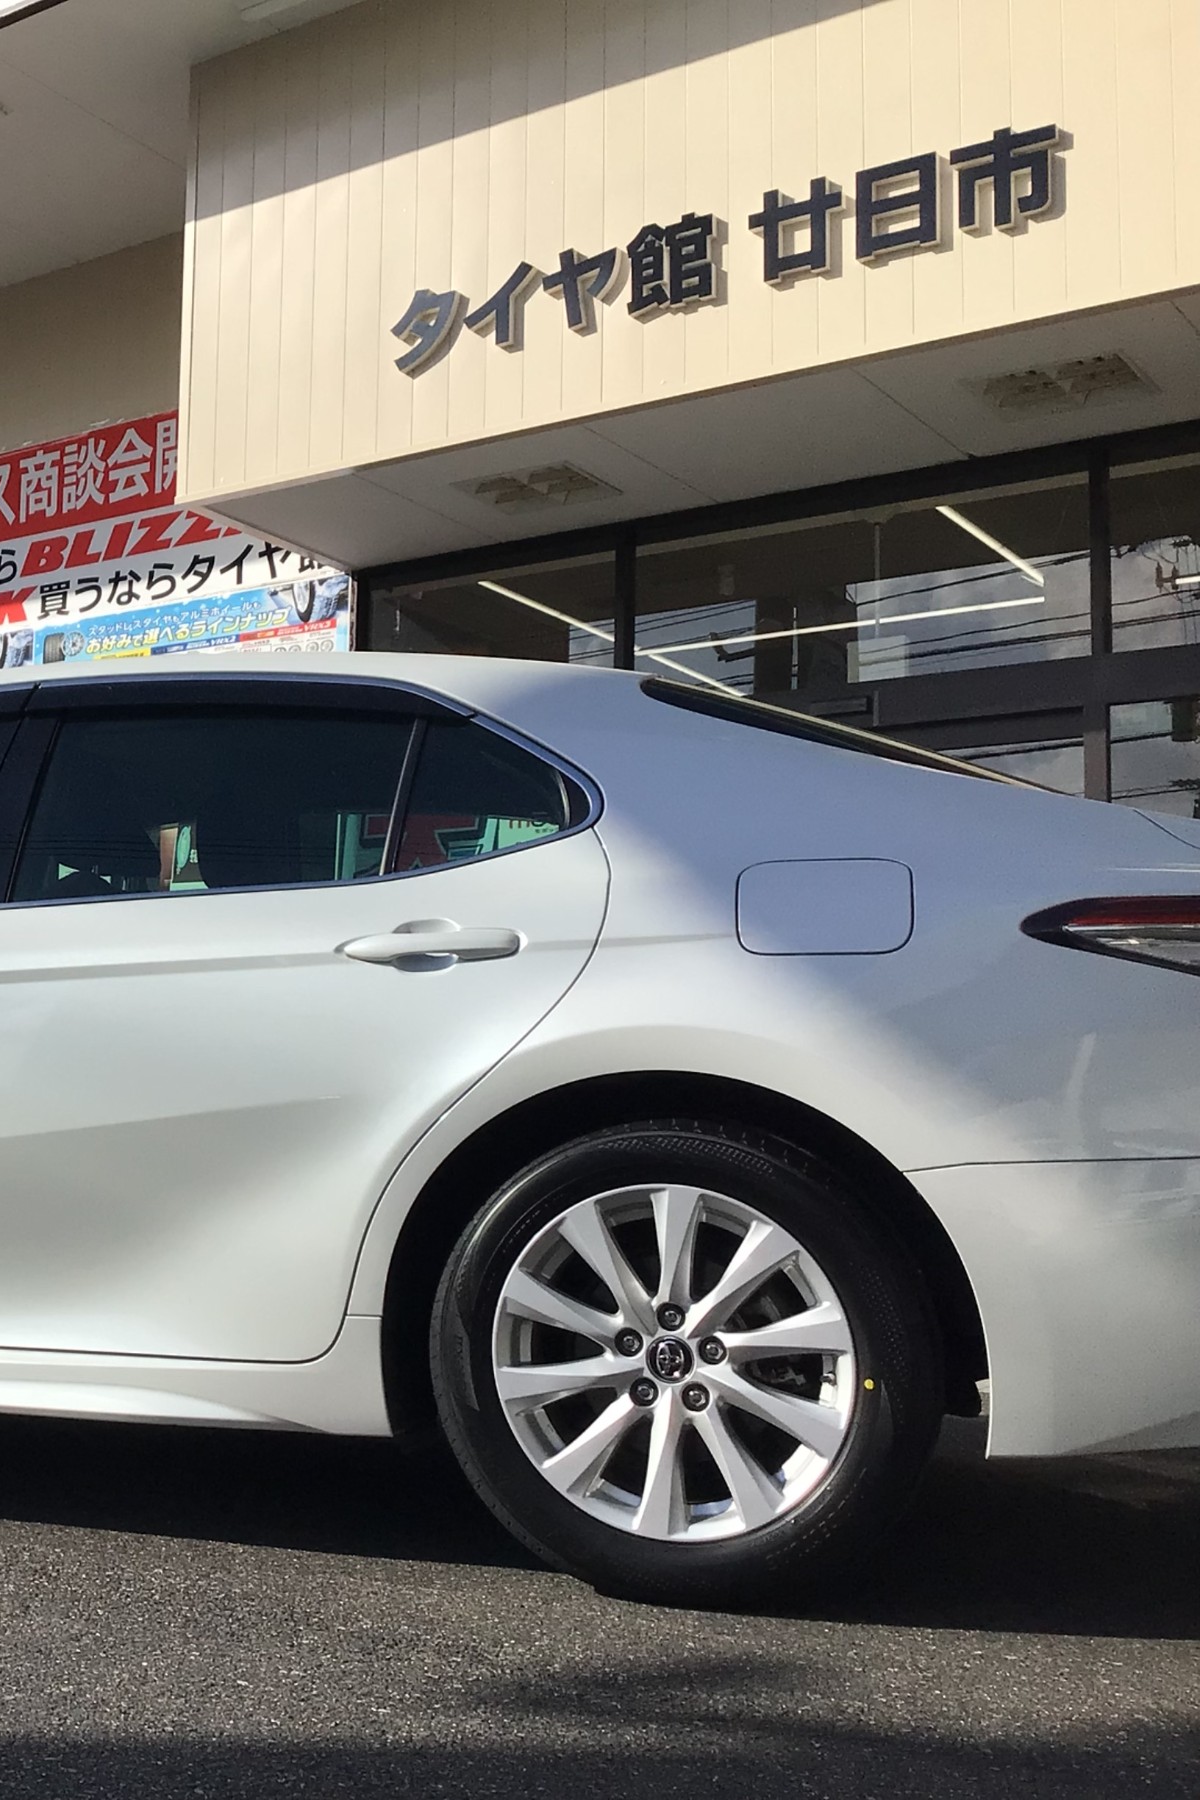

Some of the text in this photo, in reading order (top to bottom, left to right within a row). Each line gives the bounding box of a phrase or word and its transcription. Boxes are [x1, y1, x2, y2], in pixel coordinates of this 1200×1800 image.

[390, 123, 1063, 378] タイヤ館 廿日市
[20, 509, 243, 578] BLIZZ
